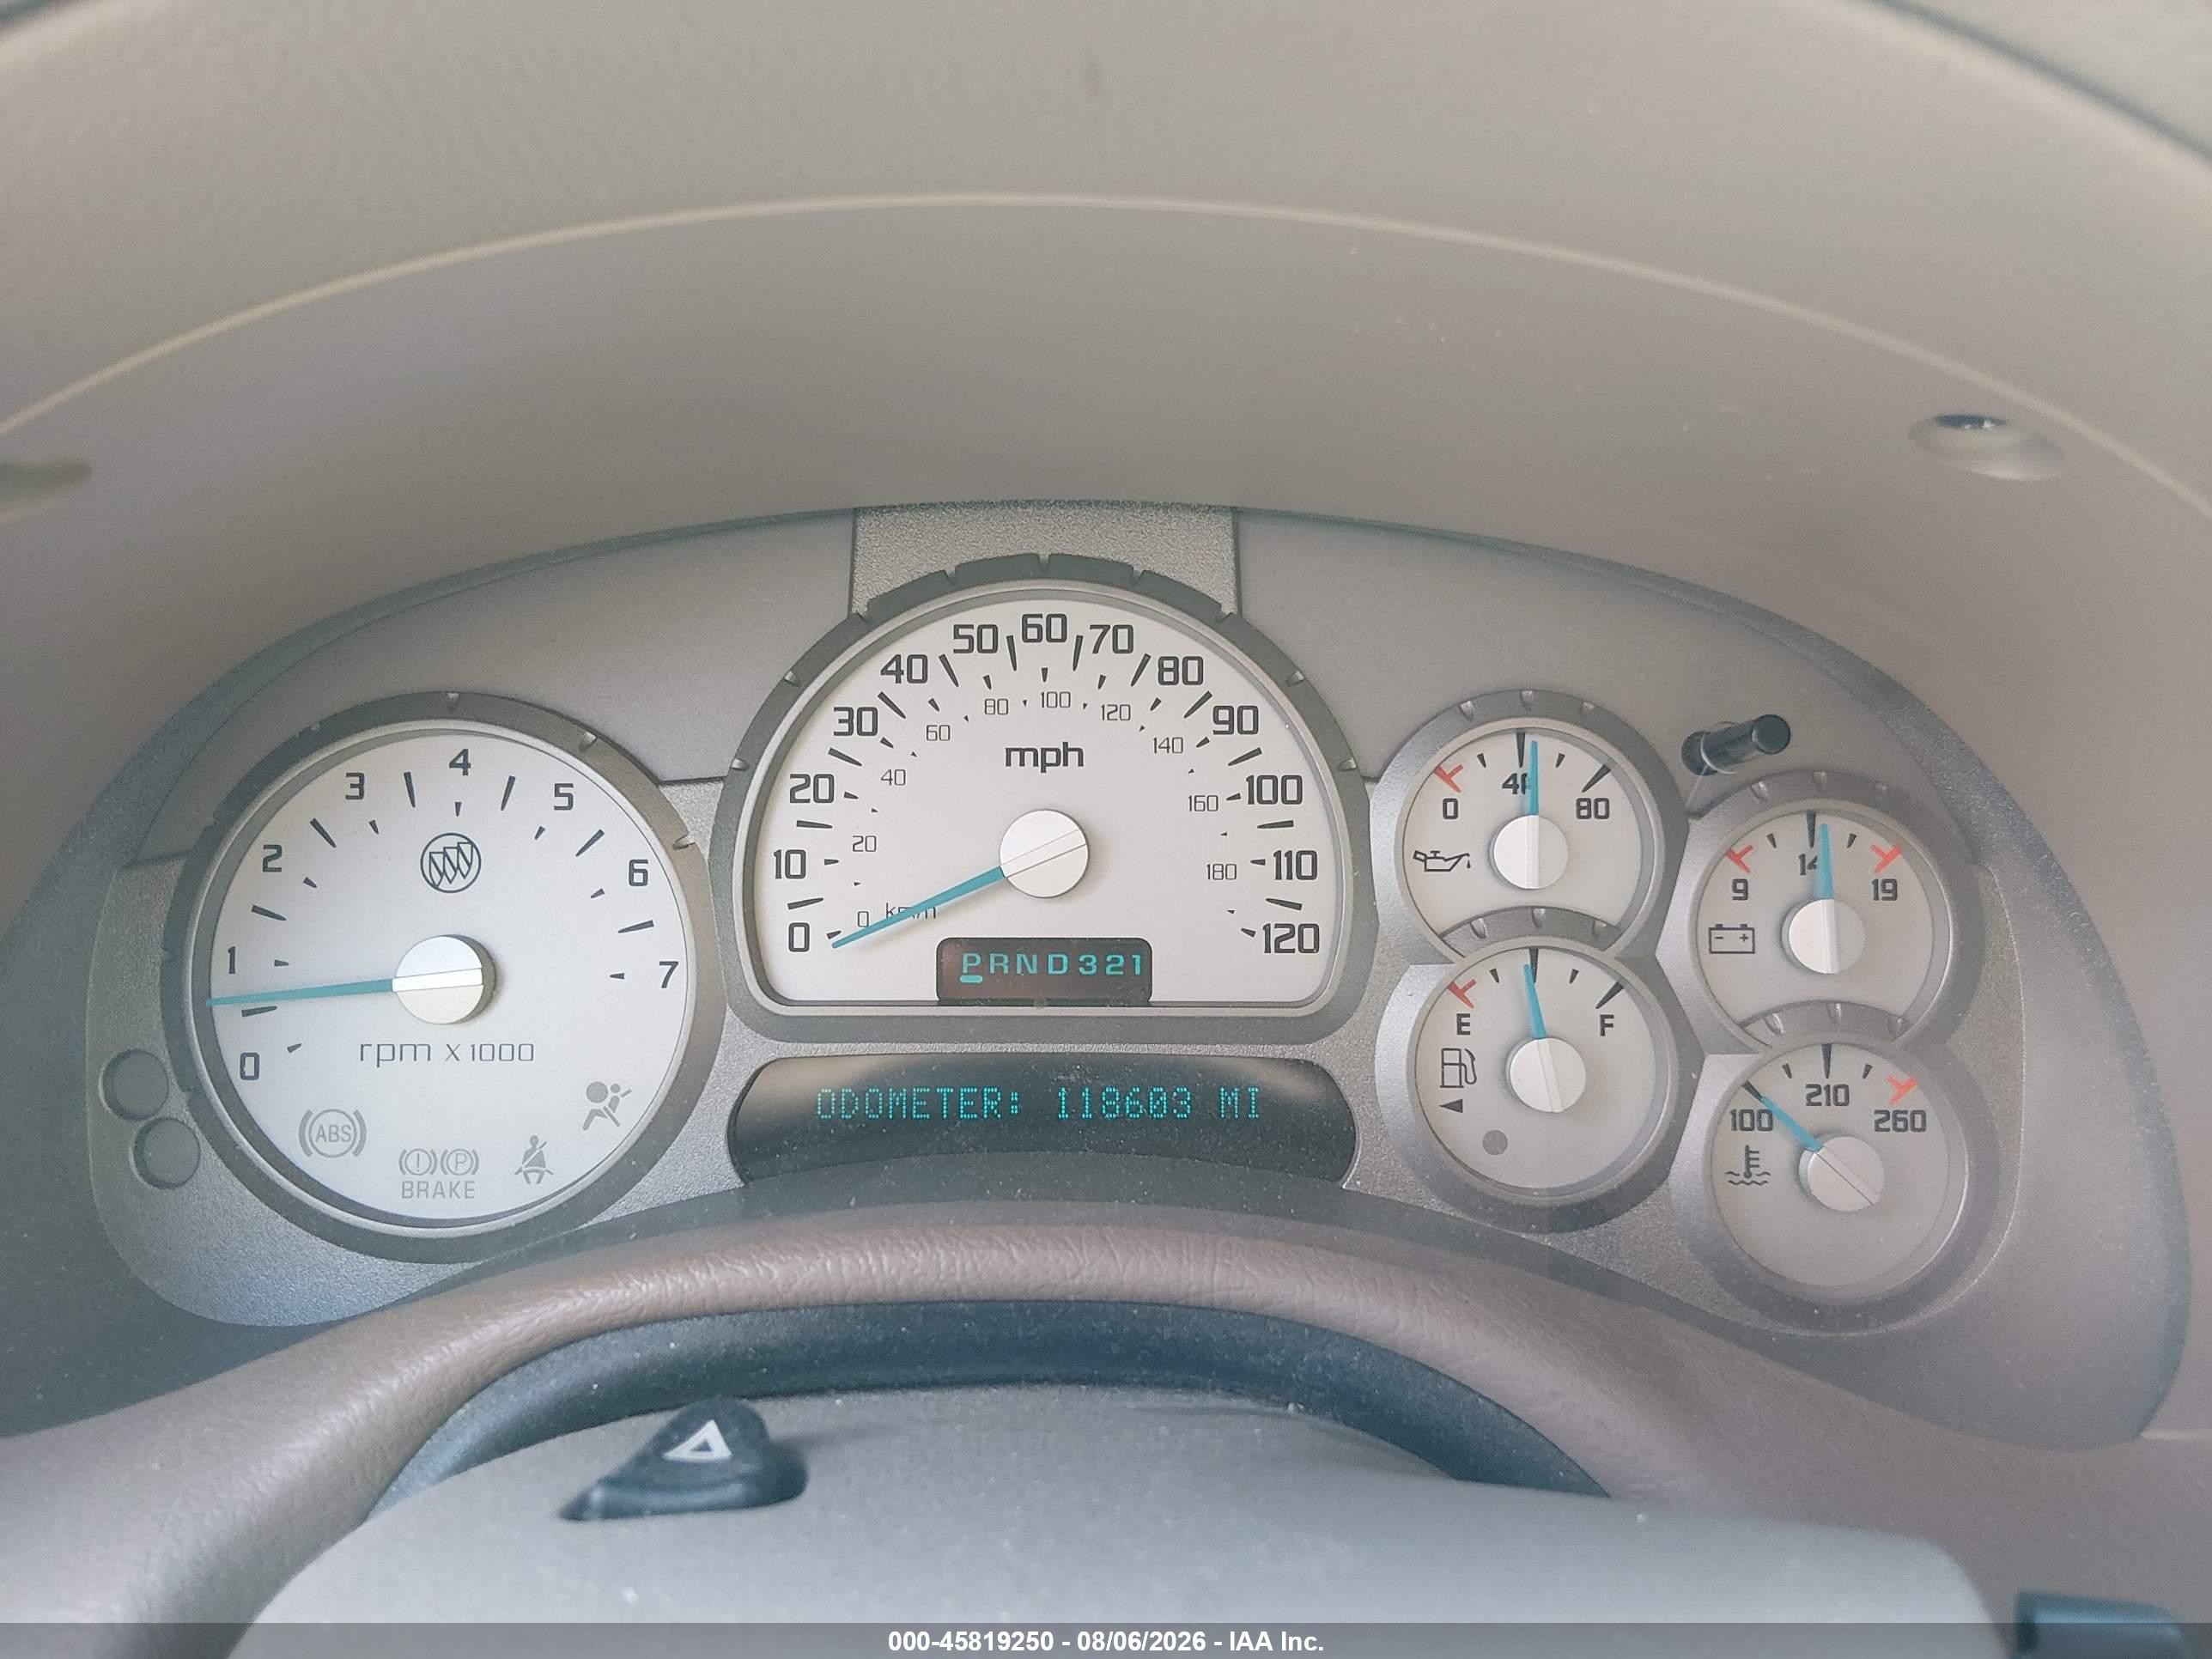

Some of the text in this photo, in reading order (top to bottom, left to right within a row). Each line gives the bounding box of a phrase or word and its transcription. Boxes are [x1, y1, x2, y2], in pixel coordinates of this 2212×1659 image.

[952, 624, 999, 653] 50
[1021, 614, 1067, 643] 60
[1090, 624, 1133, 654] 70
[880, 654, 928, 684] 40
[1158, 656, 1204, 685] 80
[984, 699, 1008, 715] 80
[1040, 691, 1071, 708] 100
[1101, 704, 1131, 721] 120
[834, 707, 878, 736] 30
[926, 725, 951, 741] 60
[1212, 706, 1259, 735] 90
[1006, 742, 1085, 773] mph
[1153, 737, 1183, 754] 140
[449, 749, 471, 775] 4
[345, 773, 365, 799] 3
[789, 774, 834, 803] 20
[881, 769, 906, 786] 40
[1246, 775, 1302, 805] 100
[554, 783, 574, 811] 5
[1188, 795, 1218, 811] 160
[1443, 799, 1458, 819] 0
[1576, 798, 1610, 819] 80
[852, 836, 877, 852] 20
[262, 844, 283, 872] 2
[774, 849, 806, 879] 10
[1273, 850, 1317, 880] 110
[629, 860, 648, 886] 6
[1206, 864, 1237, 880] 180
[1731, 878, 1748, 901] 9
[1872, 878, 1898, 902] 19
[857, 911, 869, 927] 0
[788, 922, 810, 952] 0
[1263, 923, 1319, 954] 120
[228, 946, 236, 975] 1
[659, 961, 679, 988] 7
[1456, 1013, 1471, 1036] E
[1600, 1014, 1613, 1036] F
[240, 1053, 259, 1080] 0
[360, 1044, 431, 1068] rpm
[470, 1043, 535, 1062] 1000
[817, 1087, 1260, 1120] ODOMETER: 118603 MI
[1806, 1084, 1850, 1107] 210
[1730, 1109, 1773, 1132] 100
[1874, 1109, 1927, 1132] 260
[314, 1123, 352, 1145] ABS
[401, 1181, 475, 1199] BRAKE
